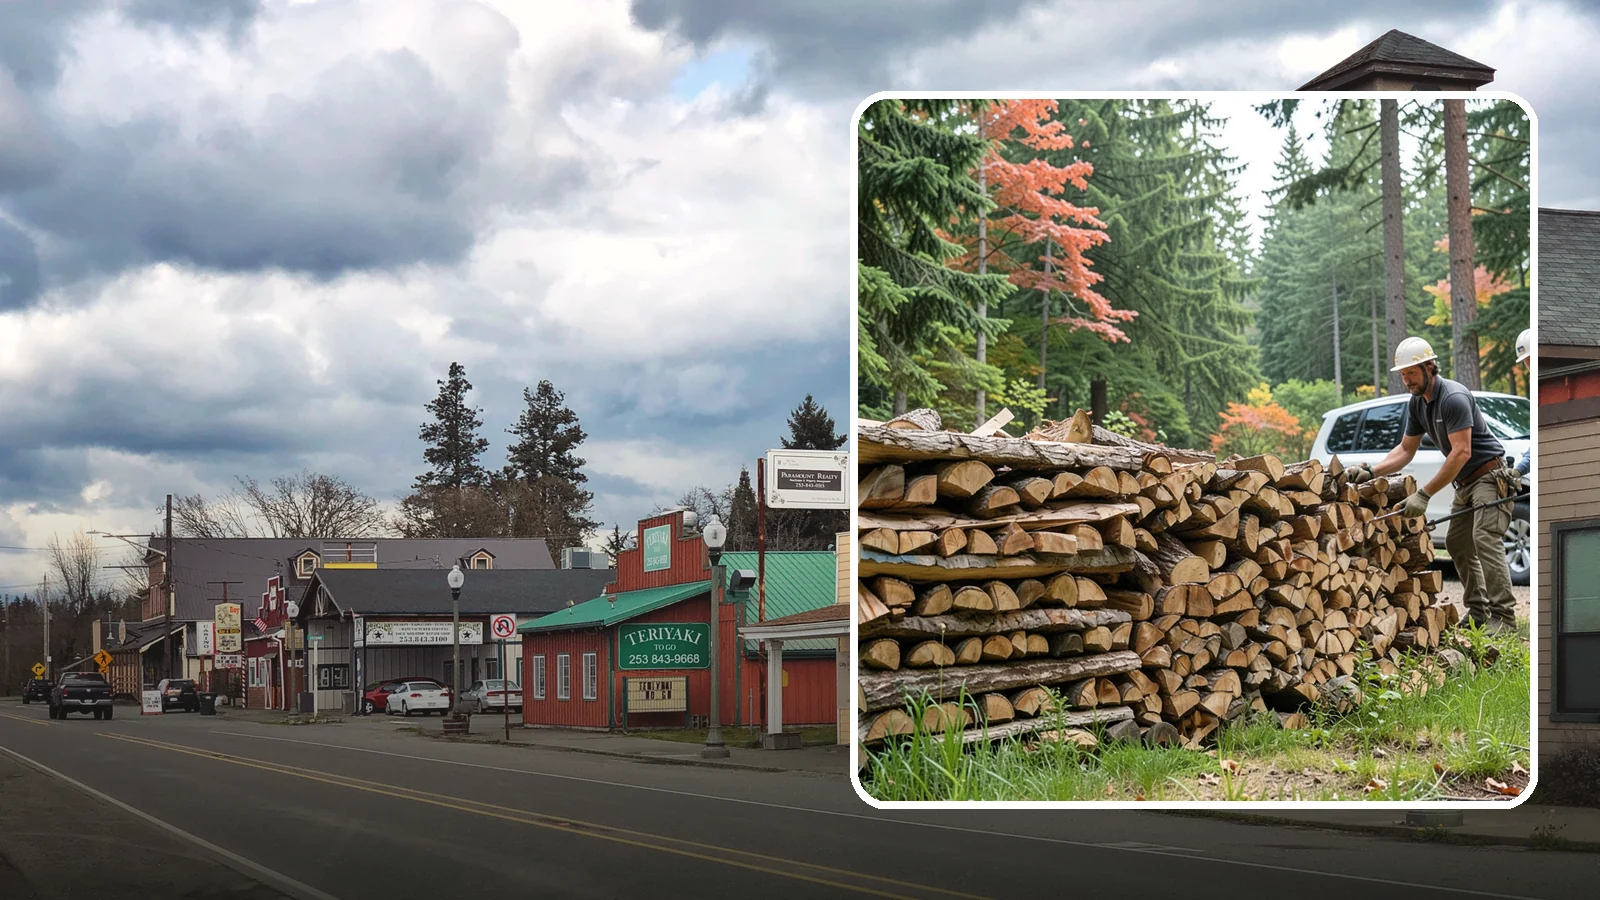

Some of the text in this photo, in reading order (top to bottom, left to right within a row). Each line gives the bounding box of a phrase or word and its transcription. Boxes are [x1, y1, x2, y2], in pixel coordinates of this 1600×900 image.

[817, 472, 838, 480] REALTY
[624, 627, 702, 646] TERIYAKI
[628, 653, 700, 664] 253 843-9668
